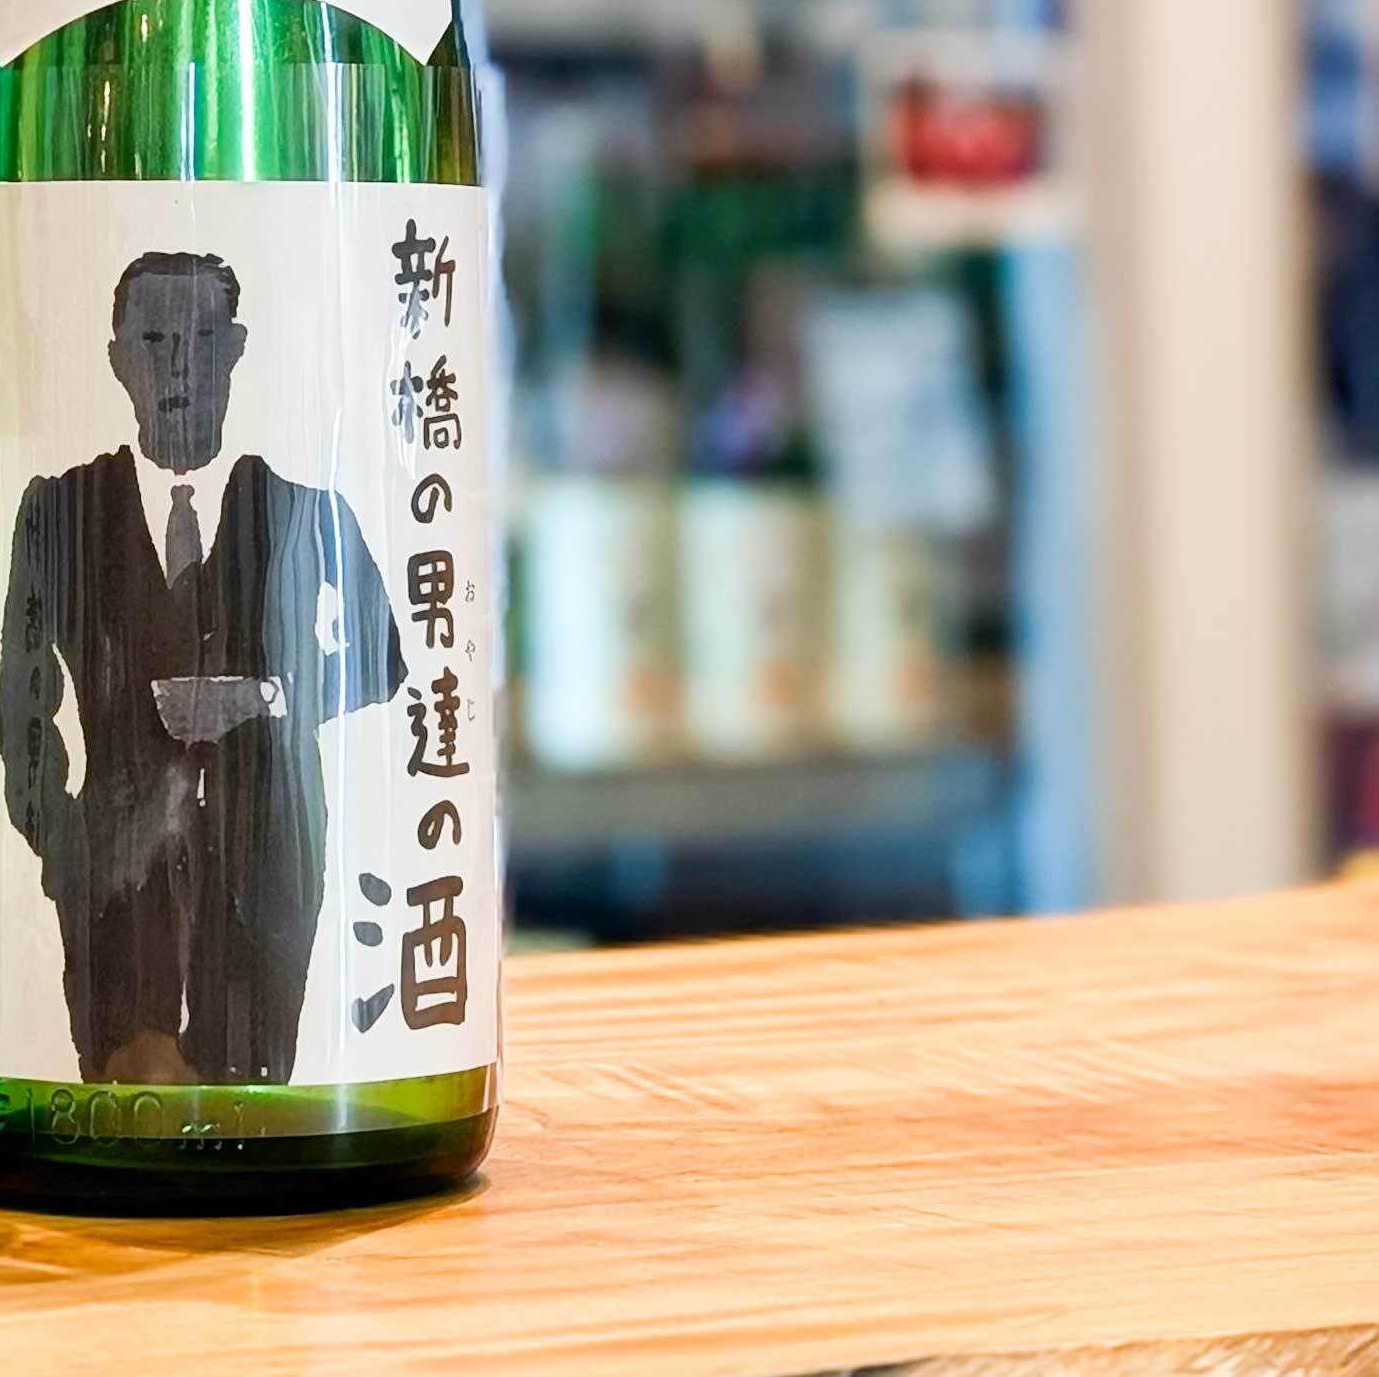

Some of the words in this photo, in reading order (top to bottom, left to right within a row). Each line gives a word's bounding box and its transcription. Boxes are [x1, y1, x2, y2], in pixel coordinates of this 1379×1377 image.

[351, 217, 471, 1034] 新橋の男達の酒
[463, 578, 477, 724] おやじ
